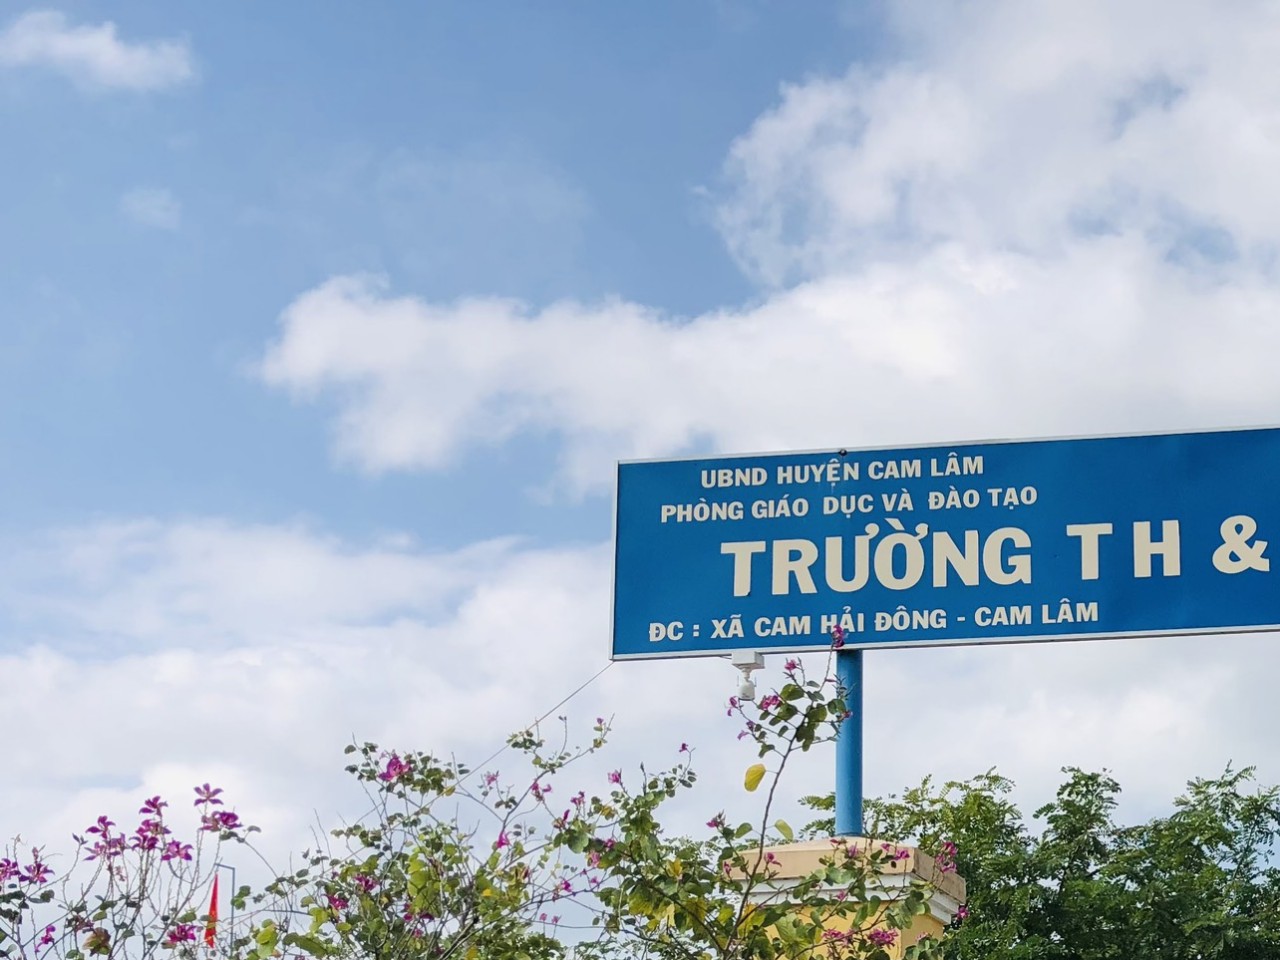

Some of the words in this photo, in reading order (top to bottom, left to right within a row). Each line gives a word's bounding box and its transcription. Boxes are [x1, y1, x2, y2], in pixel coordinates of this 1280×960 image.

[701, 467, 769, 488] UBND
[777, 459, 859, 487] HUYỆN
[868, 459, 921, 480] CAM
[931, 452, 984, 477] LÂM
[661, 497, 744, 523] PHÒNG
[752, 493, 809, 519] GIÁO
[823, 494, 874, 519] DỤC
[882, 487, 914, 512] VÀ
[928, 486, 980, 510] ĐÀO
[988, 485, 1038, 508] TẠO
[720, 517, 1032, 597] TRƯỜNG
[1212, 515, 1270, 574] &
[710, 614, 745, 639] XÃ
[754, 615, 811, 637] CAM
[820, 605, 865, 634] HẢI
[874, 605, 947, 632] ĐÔNG
[974, 605, 1032, 627] CAM
[1041, 597, 1098, 624] LÂM
